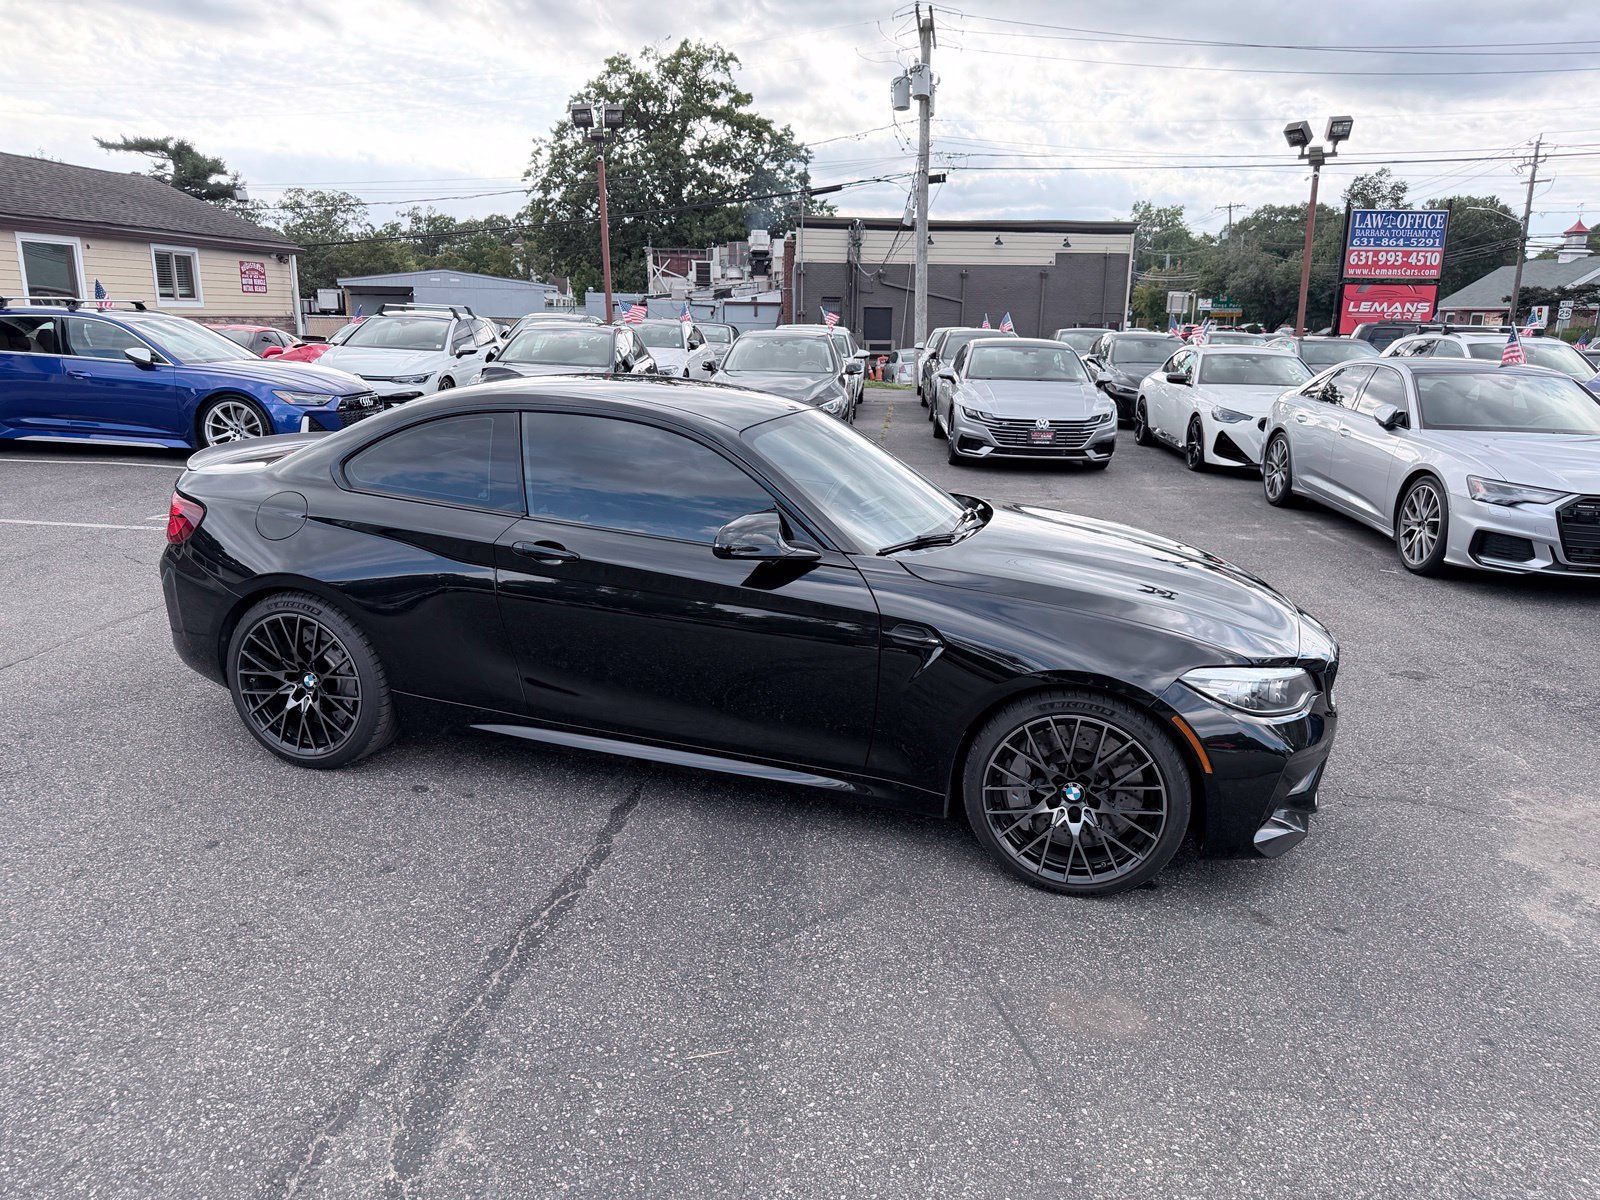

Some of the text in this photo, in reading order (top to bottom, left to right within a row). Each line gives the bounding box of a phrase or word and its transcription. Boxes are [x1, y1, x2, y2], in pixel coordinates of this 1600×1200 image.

[1354, 213, 1446, 229] LAW OFFICE
[1355, 229, 1441, 238] BARBARA TOUHAMY PC
[1352, 238, 1441, 247] 631-864-5291
[1349, 251, 1440, 266] 631-993-4510
[1348, 267, 1437, 276] www.LemansCars.com
[1347, 301, 1432, 313] LEMANS
[1384, 313, 1422, 321] CARS
[1053, 701, 1113, 714] MICHELIN
